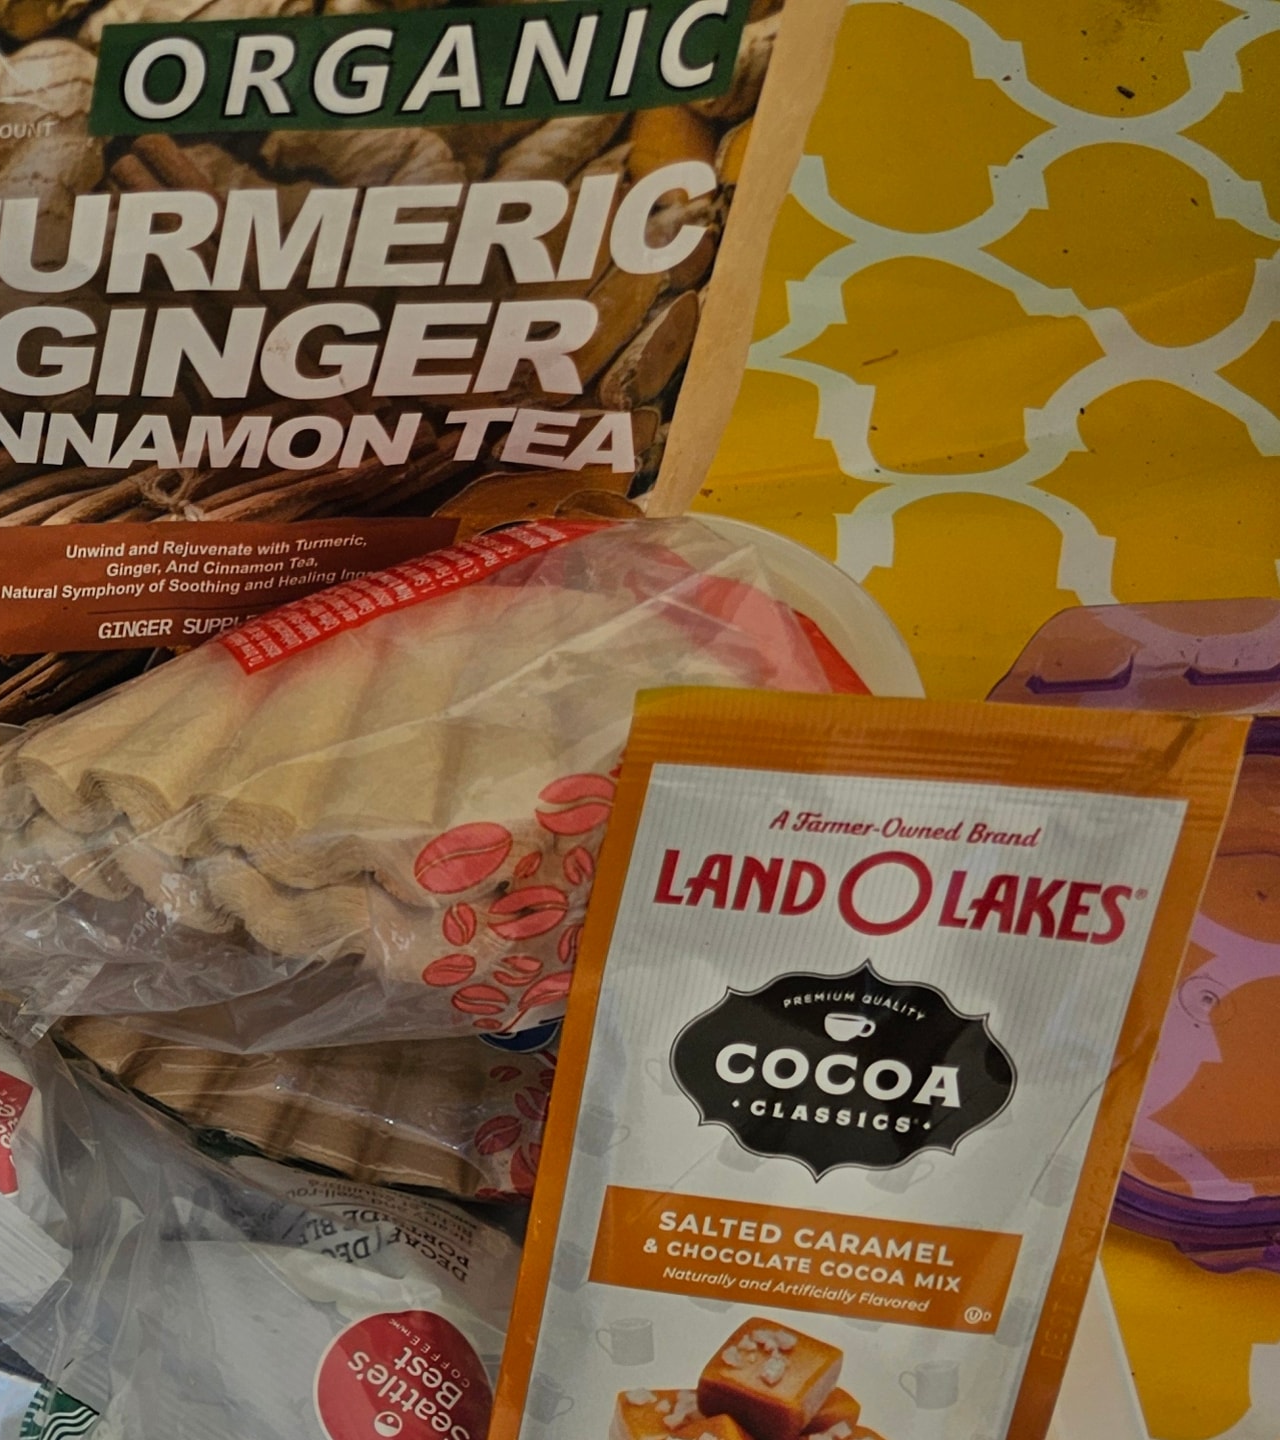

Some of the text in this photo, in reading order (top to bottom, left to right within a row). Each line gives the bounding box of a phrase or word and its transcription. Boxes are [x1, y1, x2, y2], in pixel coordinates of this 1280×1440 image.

[121, 0, 734, 121] ORGANIC
[445, 408, 636, 472] TEA
[66, 534, 368, 560] Unwind and Rejuvenate with Turmeric,
[107, 556, 319, 578] Ginger, And Cinnamon Tea,
[1, 584, 58, 600] Natural
[62, 582, 144, 601] Symphony
[148, 579, 166, 594] of
[168, 575, 241, 596] Soothing
[244, 574, 274, 591] and
[278, 570, 336, 589] Healing
[769, 809, 1043, 849] A Farmer-Owned Brand
[652, 848, 1136, 946] LAND O LAKES
[782, 989, 929, 1024] PREMIUM QUALITY
[714, 1042, 964, 1111] COCOA
[749, 1101, 913, 1136] CLASSICS
[642, 1237, 963, 1294] & CHOCOLATE COCOA MIX
[658, 1210, 956, 1269] SALTED CARAMEL
[661, 1266, 930, 1314] Naturally and Artificially Flavored
[393, 1345, 464, 1411] Best
